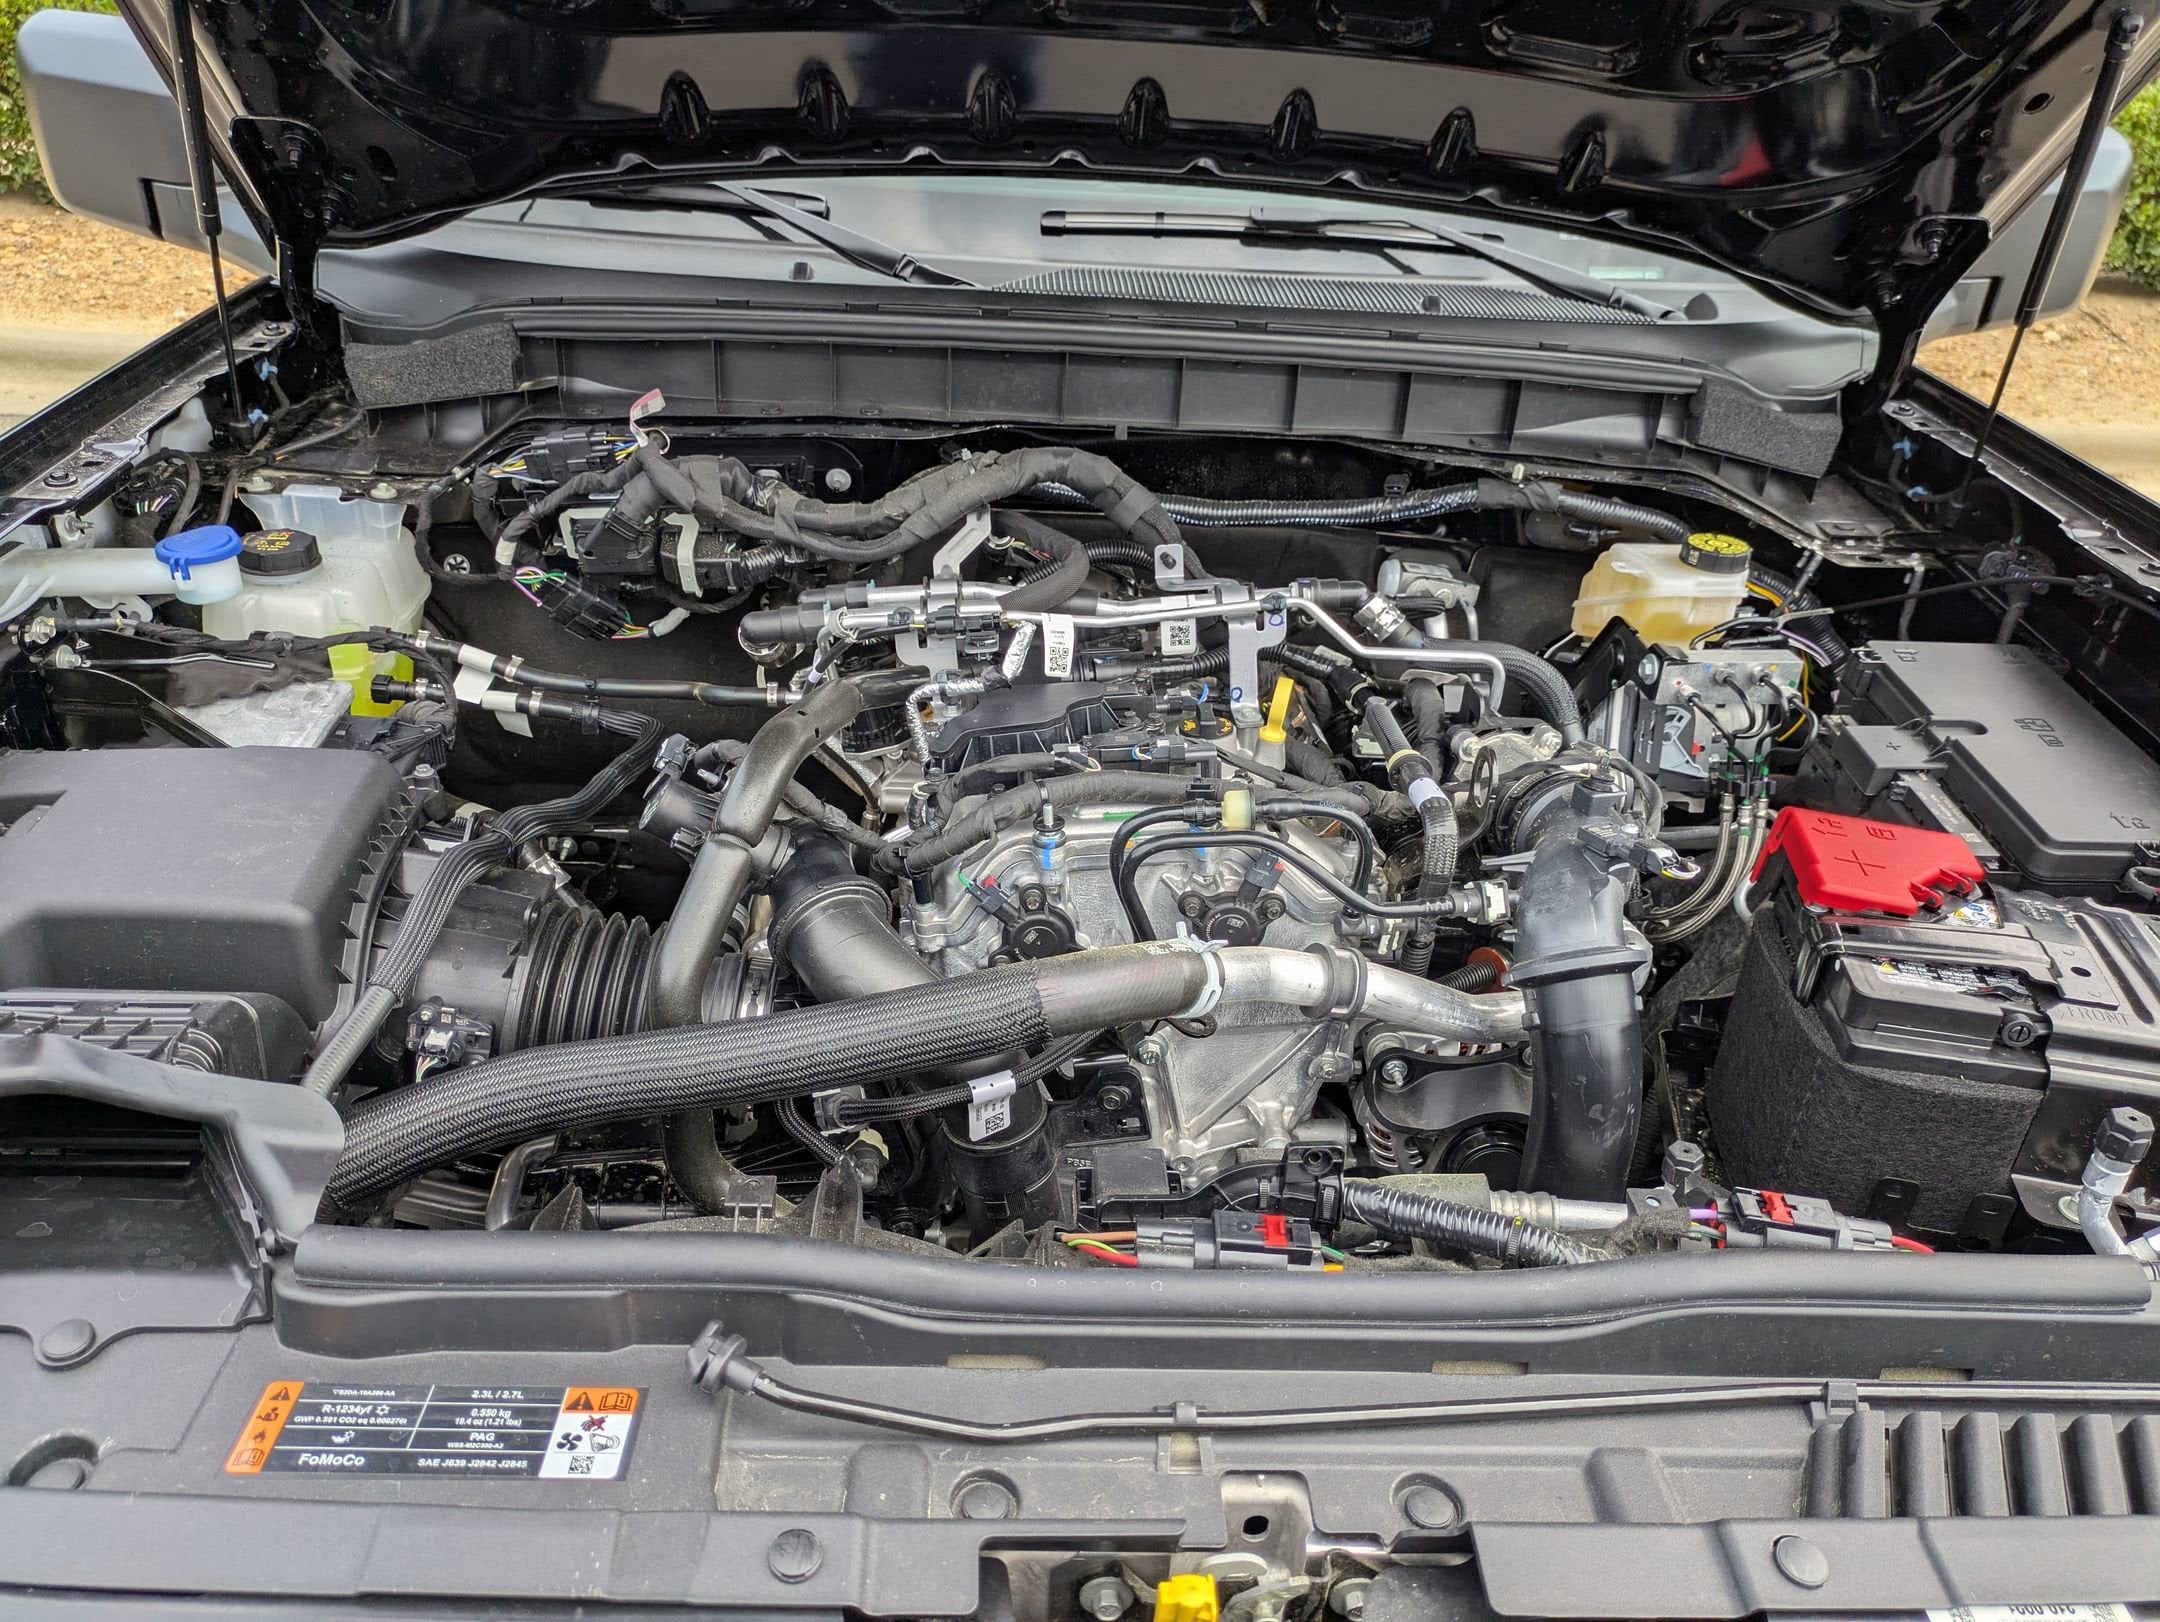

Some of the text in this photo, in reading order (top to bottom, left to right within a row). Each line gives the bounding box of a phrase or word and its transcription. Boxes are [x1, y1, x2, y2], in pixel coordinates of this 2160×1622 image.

[2066, 1005, 2129, 1026] FRONT
[471, 1390, 494, 1399] 2.3L
[501, 1390, 524, 1400] 2.7L
[321, 1404, 374, 1416] R-1234yf
[470, 1408, 512, 1419] 0.550 kg
[294, 1415, 315, 1423] GWP
[339, 1416, 356, 1424] CO2
[357, 1418, 368, 1426] eq
[455, 1417, 472, 1425] 19.4
[484, 1418, 504, 1427] (1.21
[505, 1418, 522, 1427] lbs)
[469, 1432, 496, 1441] PAG
[298, 1453, 366, 1466] FoMoCo
[417, 1458, 528, 1468] SAE J639 J2842 J2845
